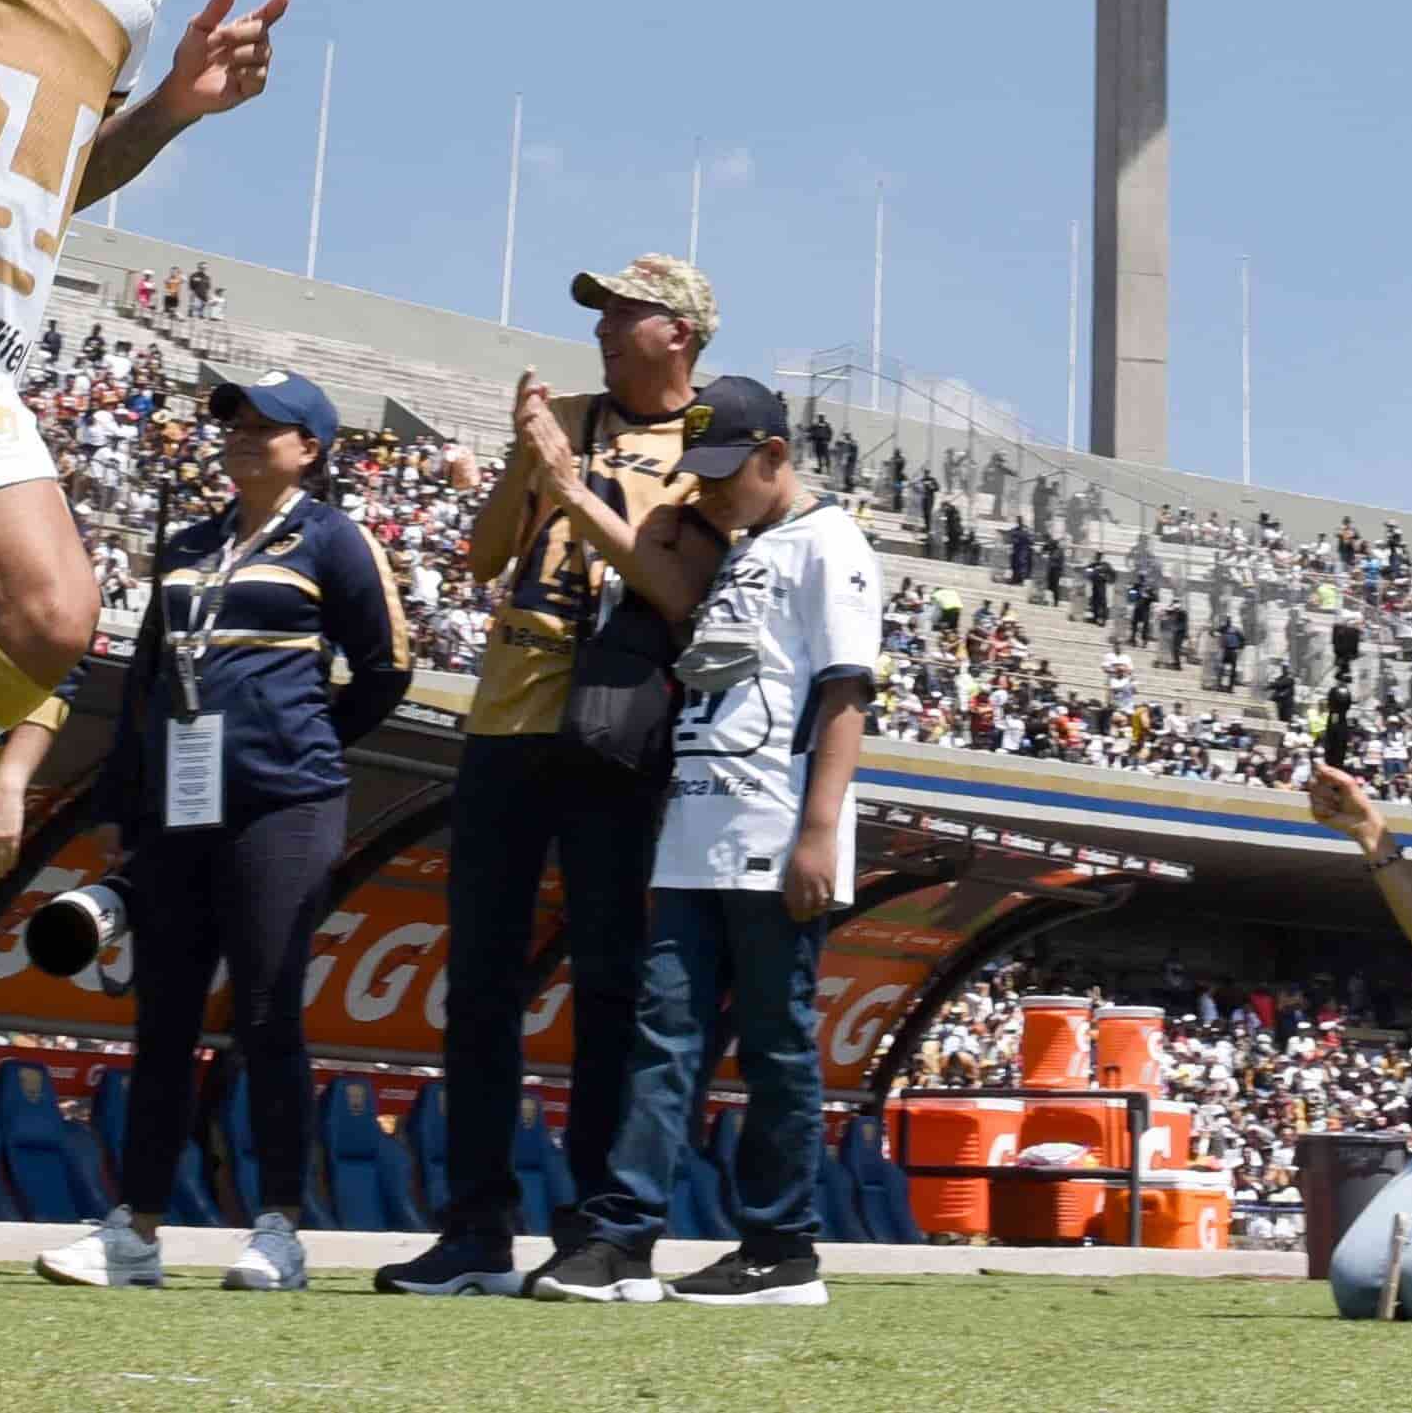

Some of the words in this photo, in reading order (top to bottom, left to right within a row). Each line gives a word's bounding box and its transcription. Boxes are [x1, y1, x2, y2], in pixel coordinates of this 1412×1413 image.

[345, 921, 449, 1023] G
[830, 984, 909, 1066] G
[1198, 1207, 1220, 1250] G
